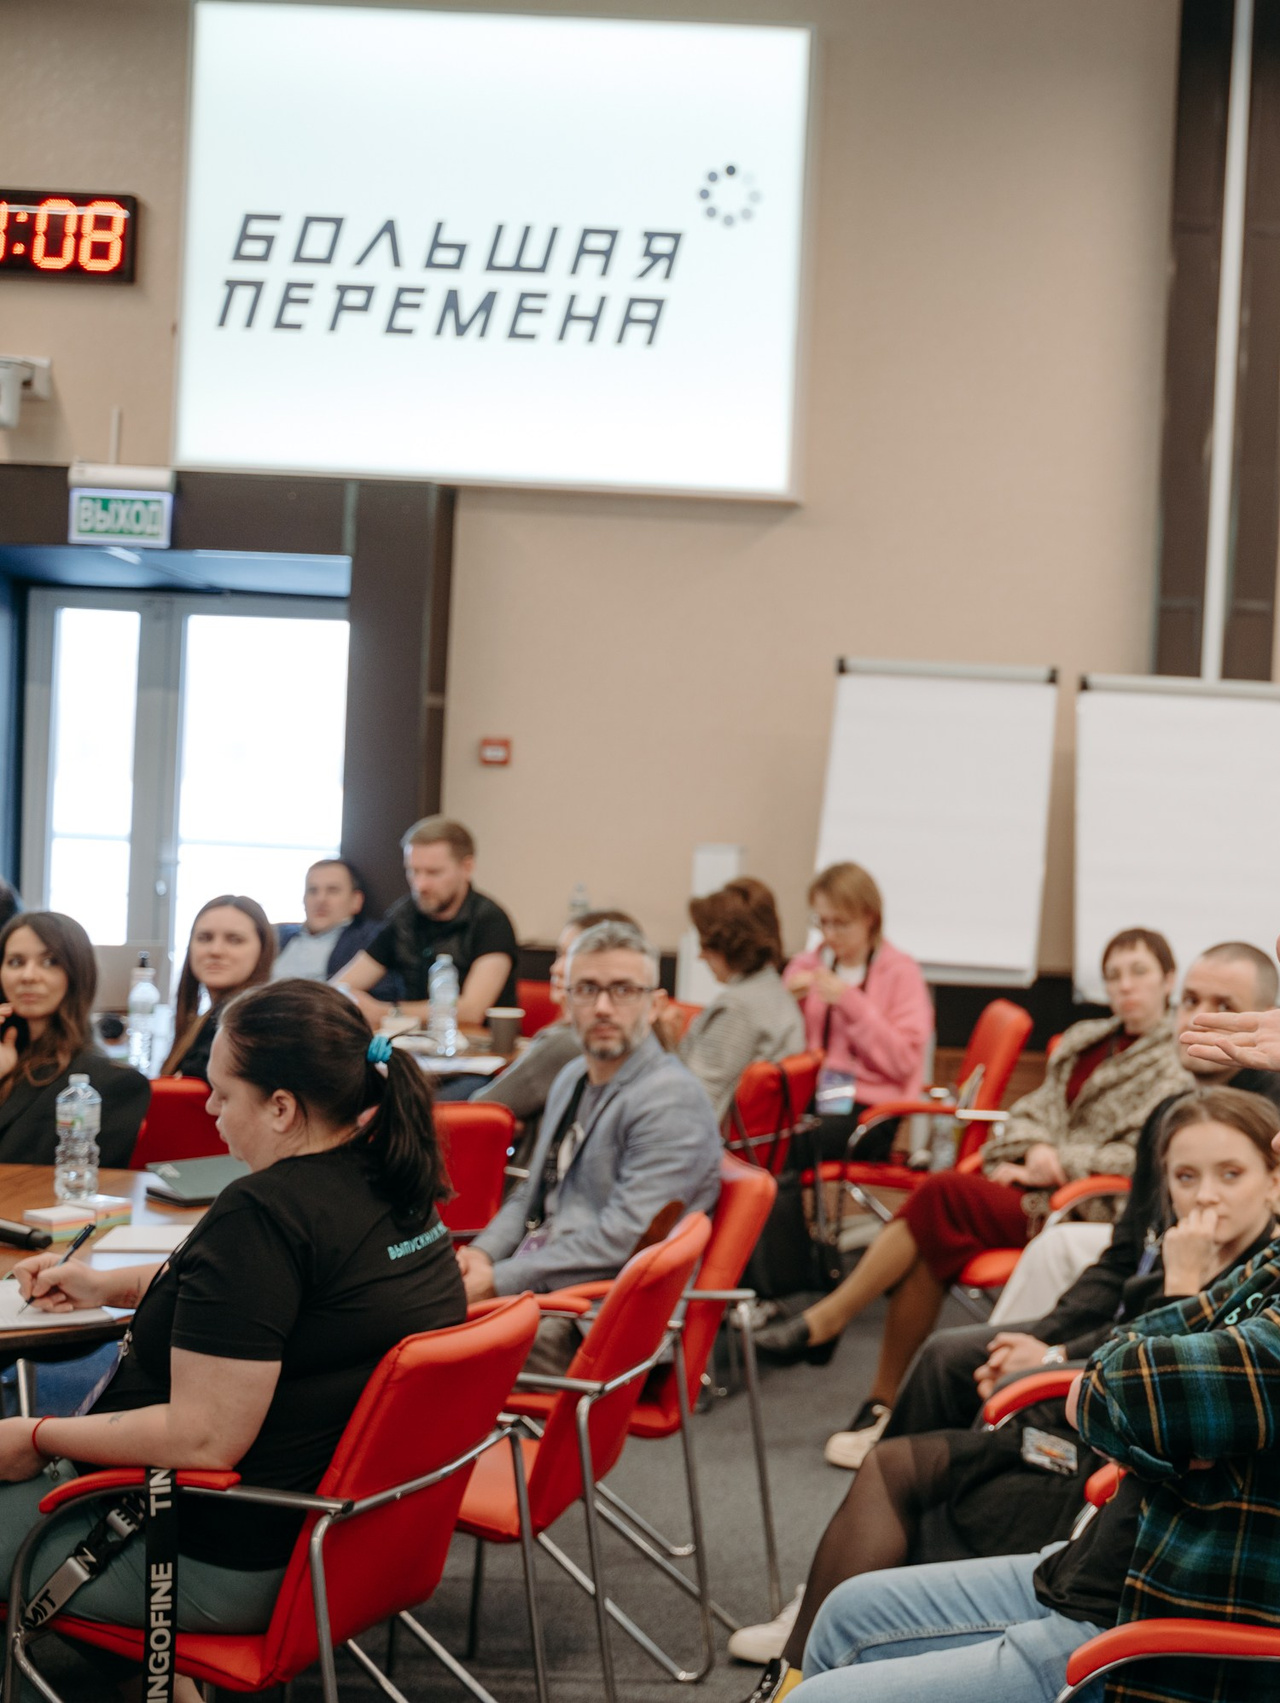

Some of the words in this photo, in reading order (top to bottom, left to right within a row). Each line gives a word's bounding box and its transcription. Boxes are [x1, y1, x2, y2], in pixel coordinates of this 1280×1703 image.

[0, 198, 126, 272] :08
[232, 213, 683, 281] БОЛЬШАЯ
[218, 279, 666, 347] ПЕРЕМЕНА
[79, 498, 162, 536] ВЫХОД
